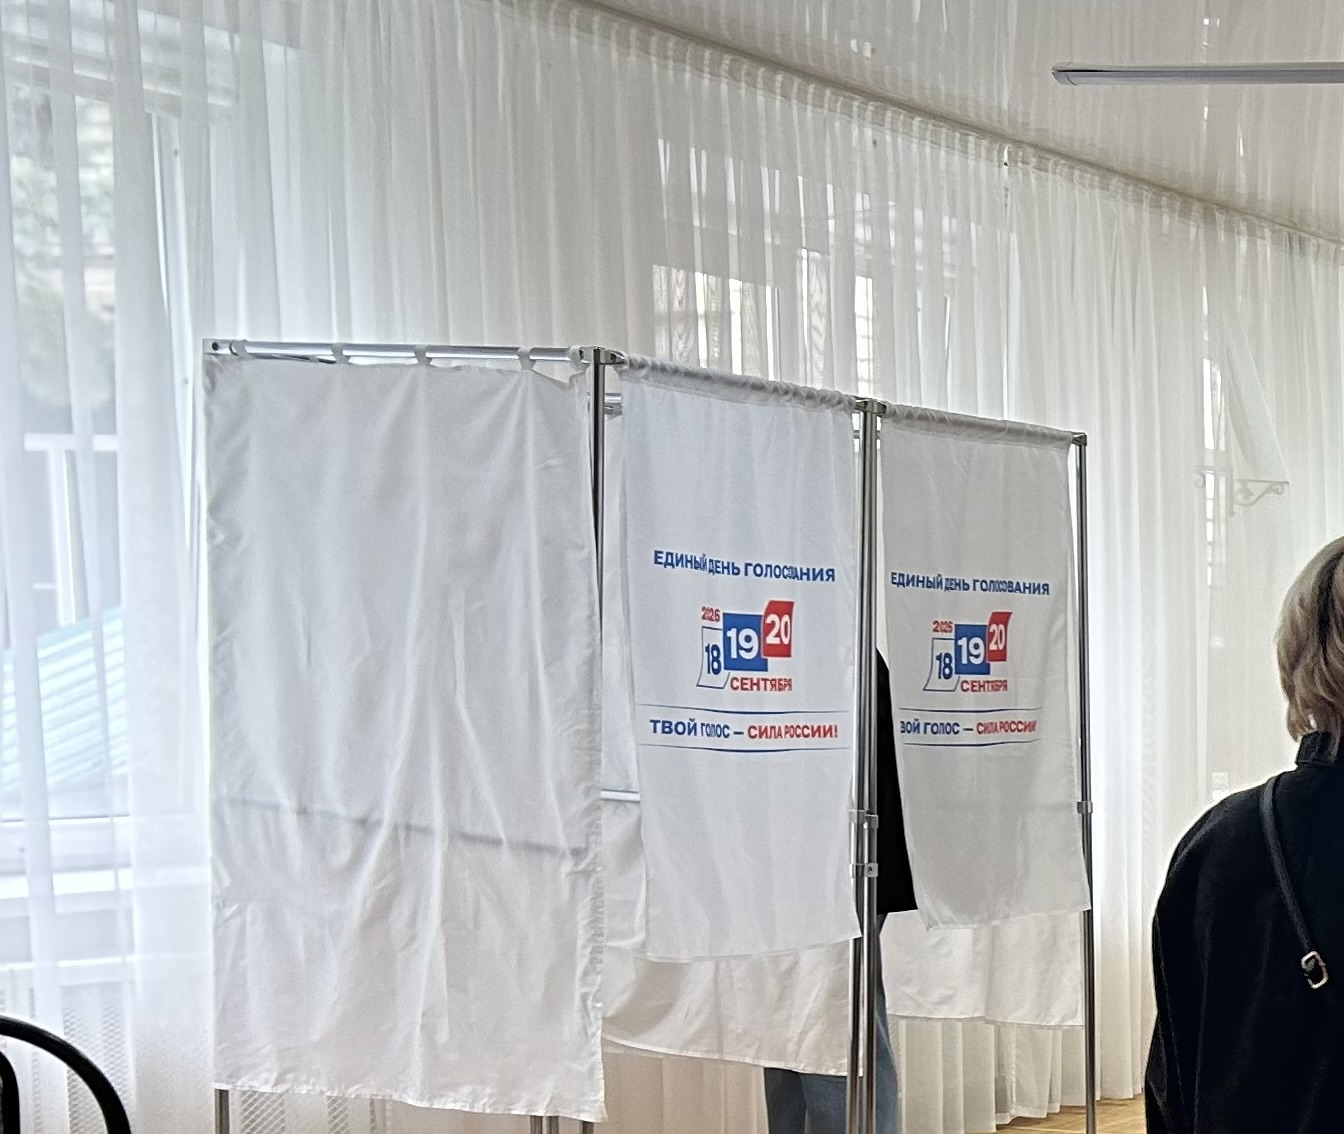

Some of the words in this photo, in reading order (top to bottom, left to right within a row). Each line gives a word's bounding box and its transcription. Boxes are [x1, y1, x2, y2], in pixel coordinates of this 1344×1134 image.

[654, 550, 707, 572] ЕДИНЫЙ
[708, 558, 740, 576] ДЕНЬ
[744, 562, 835, 582] ГОЛОСАНИЯ
[891, 572, 943, 590] ЕДИНЫЙ
[944, 578, 970, 592] ДЕНЬ
[973, 579, 1050, 595] ГОЛОВАНИЯ
[705, 644, 721, 675] 18
[727, 628, 759, 659] 19
[765, 614, 791, 644] 20
[936, 653, 953, 679] 18
[958, 637, 985, 664] 19
[990, 624, 1005, 650] 20
[961, 680, 1008, 692] СЕНТРЯ
[650, 718, 697, 736] ТВОЙ
[701, 723, 730, 738] ГОЛОС
[747, 725, 783, 740] СИЛА
[784, 724, 838, 739] РОССИИ!
[900, 718, 920, 734] ВОЙ
[924, 722, 960, 735] ГОЛОС
